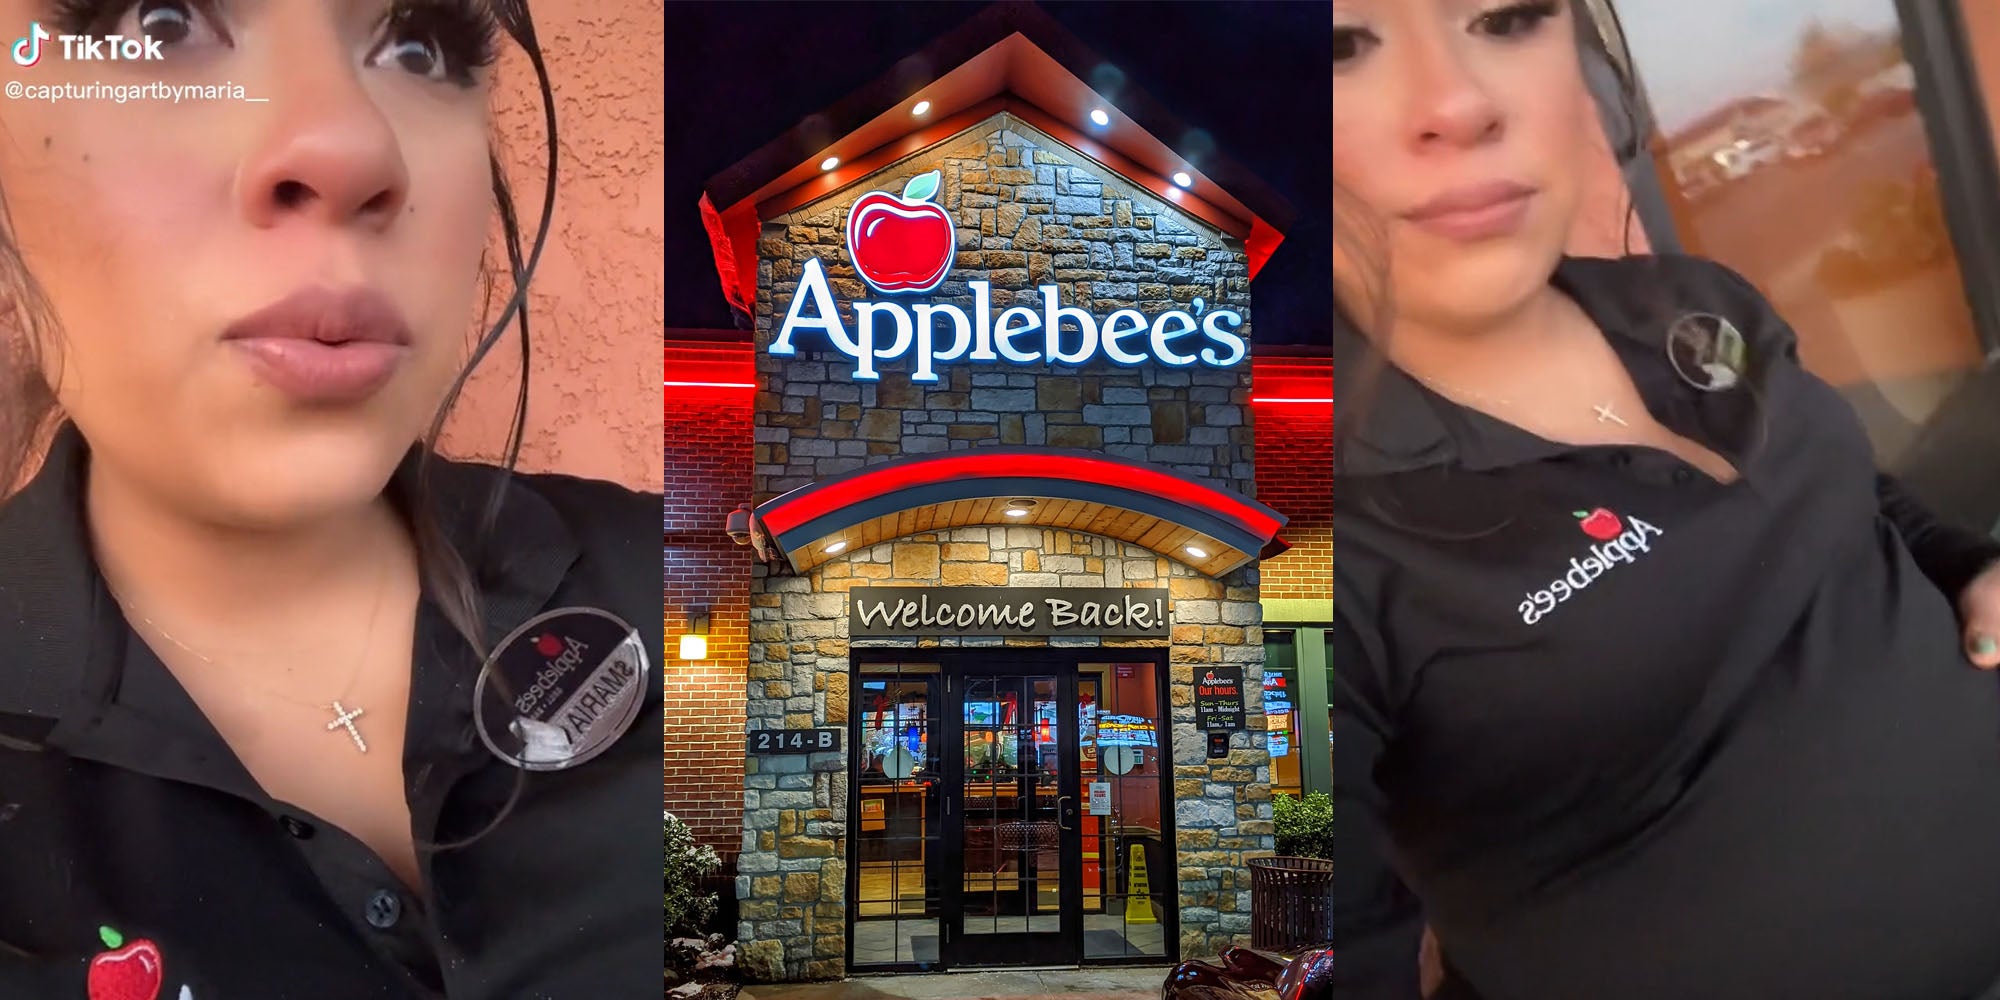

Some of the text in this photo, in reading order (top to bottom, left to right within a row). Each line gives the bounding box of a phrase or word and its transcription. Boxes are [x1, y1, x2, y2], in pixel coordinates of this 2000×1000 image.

[768, 257, 1247, 382] Applebee's
[857, 594, 1164, 628] Welcome Back!
[1199, 686, 1212, 695] Our
[758, 732, 833, 749] 214-B
